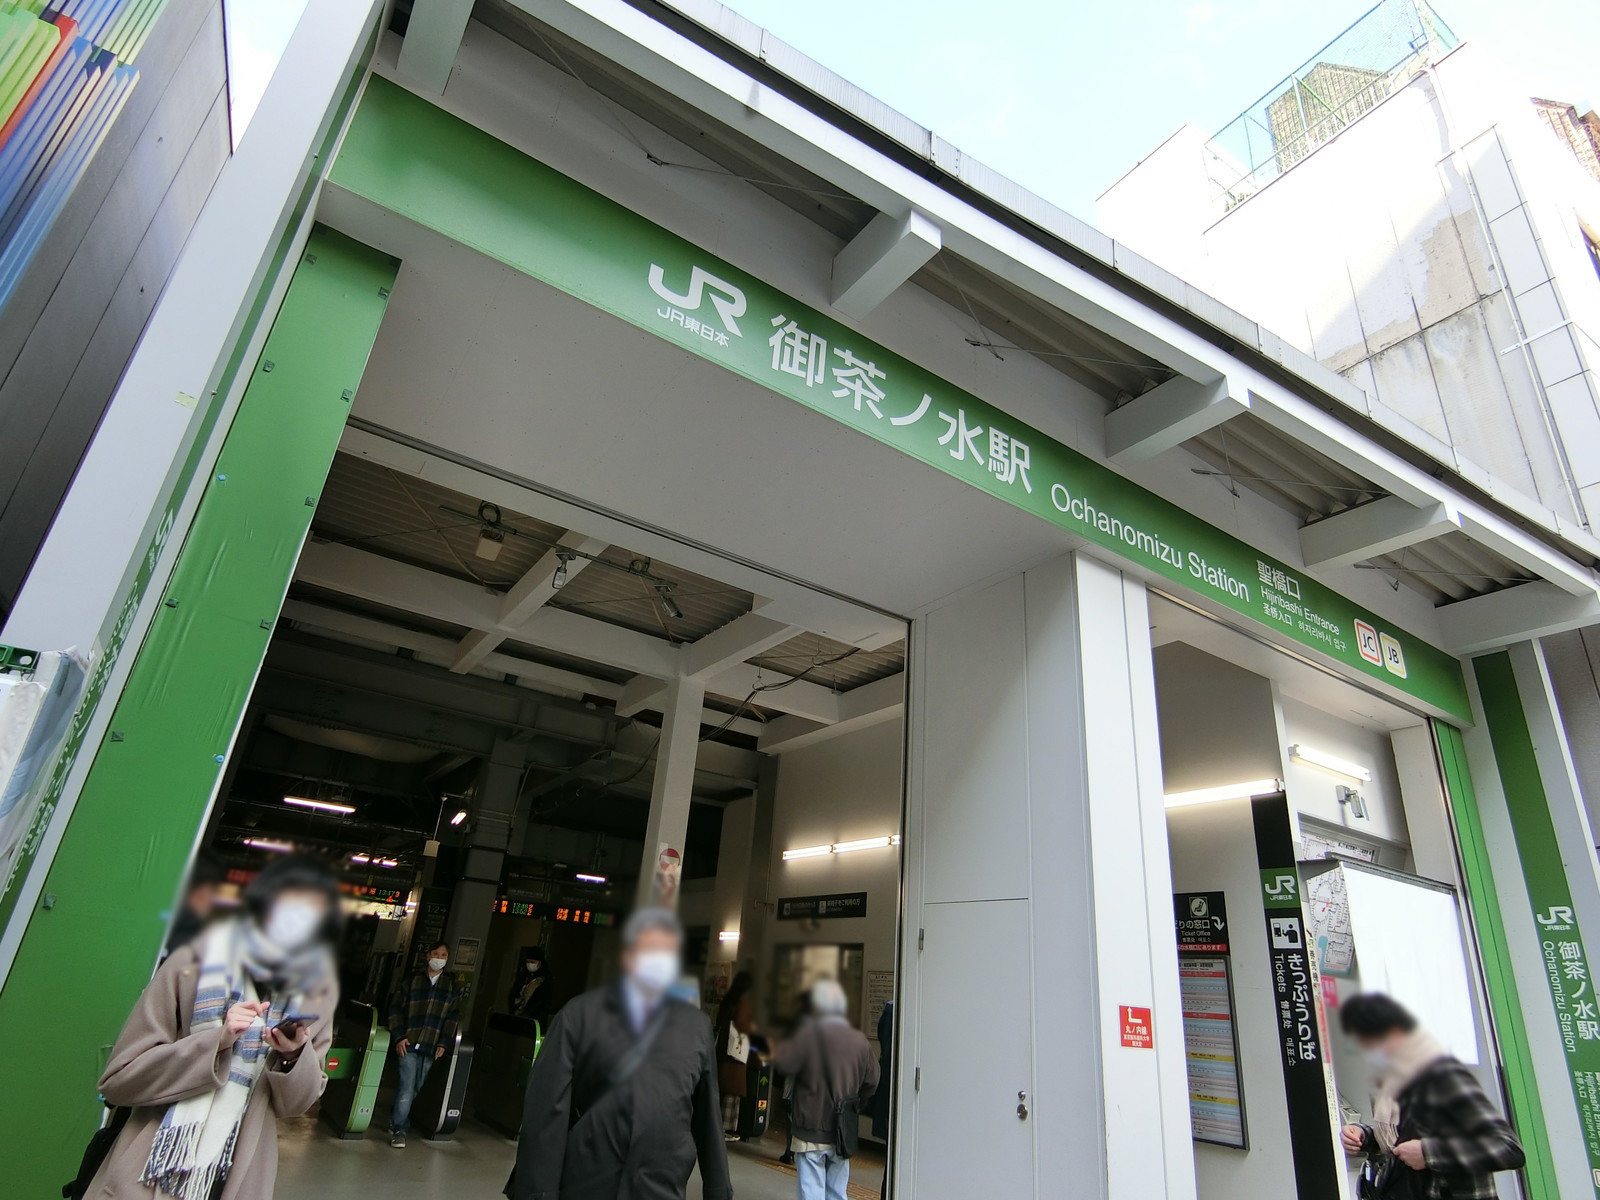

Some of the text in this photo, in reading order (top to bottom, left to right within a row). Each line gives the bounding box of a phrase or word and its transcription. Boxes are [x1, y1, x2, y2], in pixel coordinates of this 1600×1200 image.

[647, 263, 748, 338] JR
[656, 306, 730, 348] JR東日本
[768, 314, 1033, 494] 御茶ノ水駅
[1050, 483, 1250, 603] Ochanomizu Station
[1256, 559, 1301, 601] 聖橋口
[1260, 585, 1340, 636] Hijiribashi Entrance
[1262, 602, 1293, 627] 圣桥入口
[1362, 633, 1376, 653] JC
[1388, 646, 1400, 664] JB
[1264, 875, 1297, 894] JR
[1175, 919, 1211, 930] りの窓口
[1536, 906, 1575, 925] JR
[1274, 953, 1287, 993] Tickets
[1557, 941, 1600, 1041] 御茶ノ水駅
[1287, 953, 1317, 1062] きっぷうりば
[1542, 940, 1576, 1053] Ochanomizu Station
